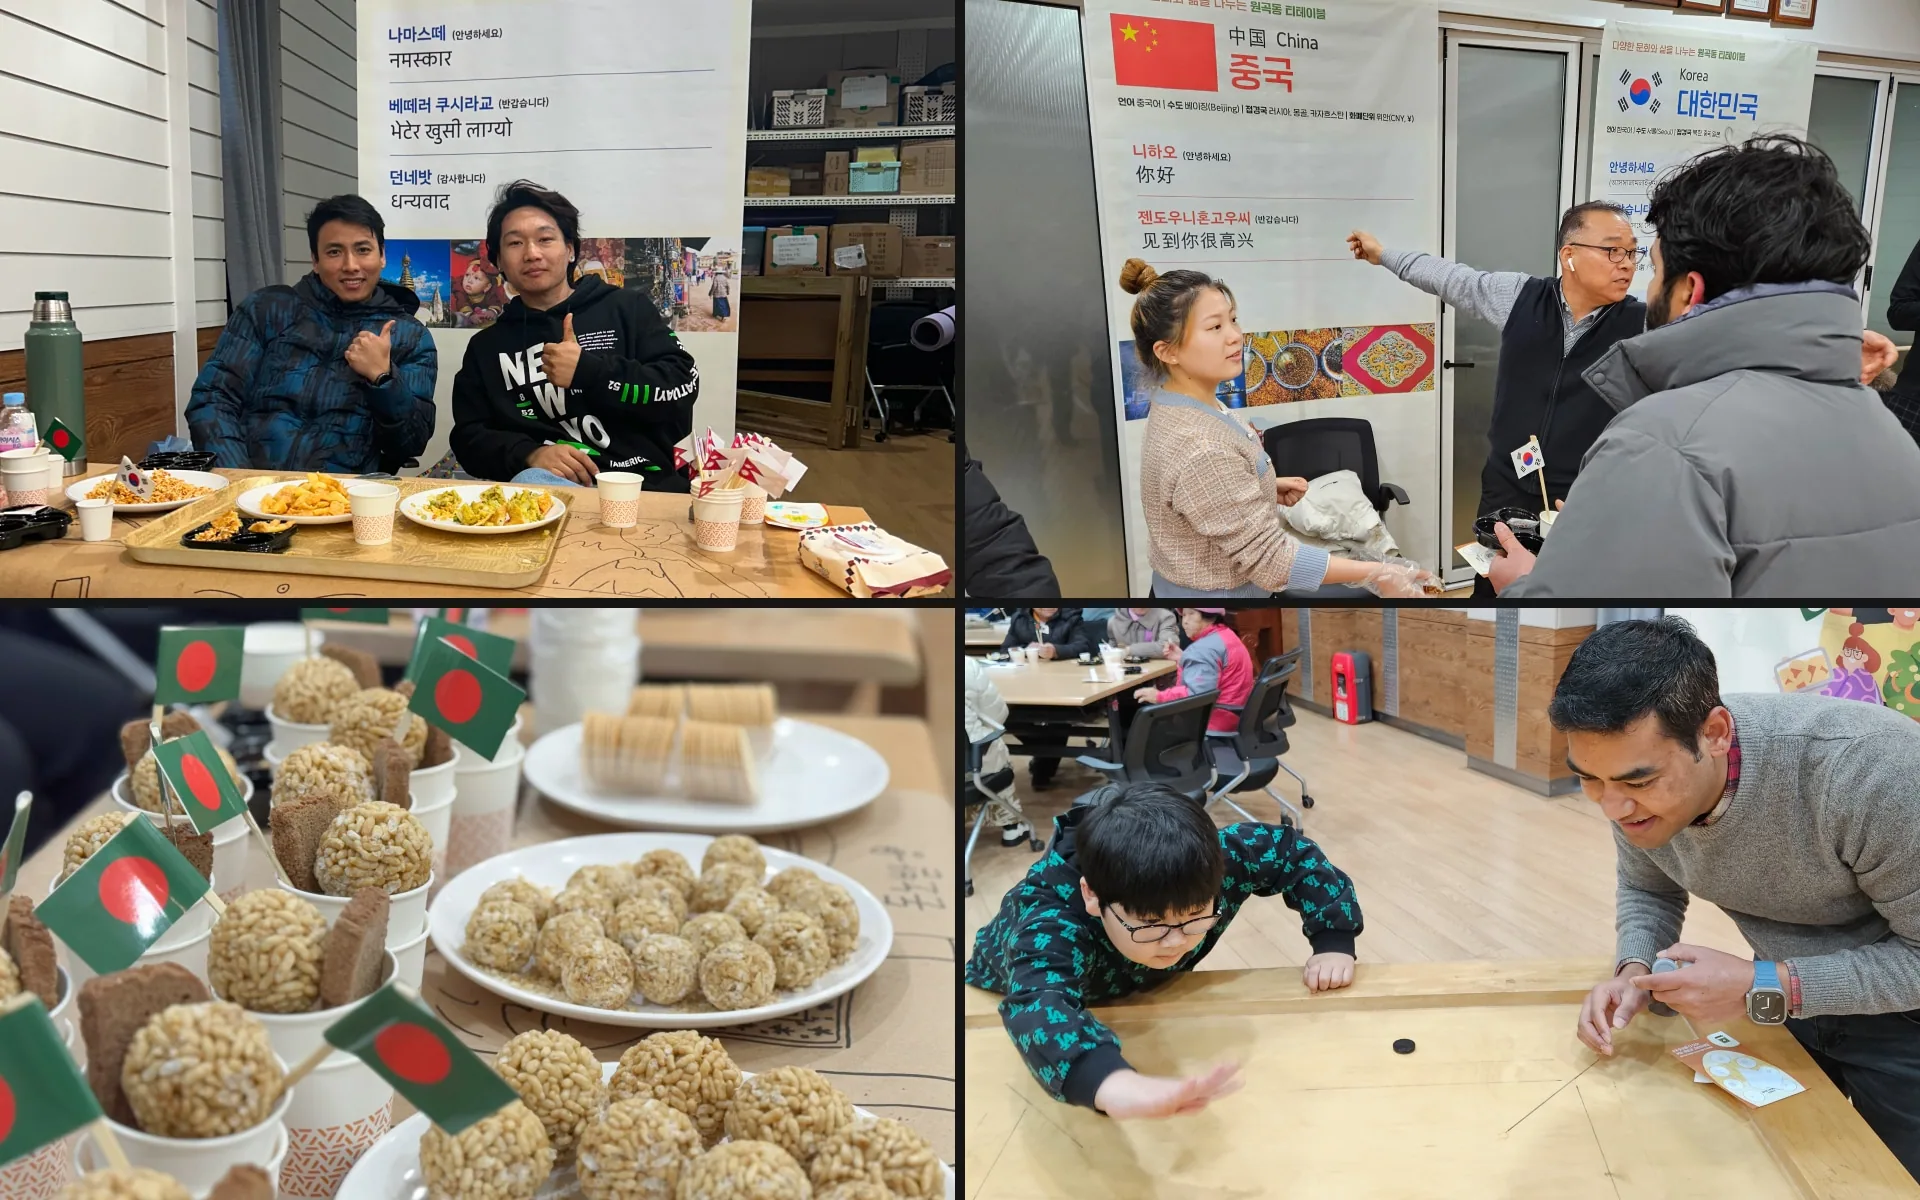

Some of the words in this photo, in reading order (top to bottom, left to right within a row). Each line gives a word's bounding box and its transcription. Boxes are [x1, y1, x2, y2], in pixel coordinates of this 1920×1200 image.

[1250, 1, 1282, 16] 원곡동
[1285, 4, 1327, 20] 티테이블
[388, 24, 446, 43] 나마스떼
[452, 28, 503, 41] (안녕하세요)
[1229, 26, 1266, 49] 中国
[1276, 31, 1319, 51] China
[1612, 40, 1635, 52] 다양한
[388, 51, 453, 68] नमस्कार
[1229, 53, 1293, 93] 중국
[1679, 68, 1709, 82] Korea
[389, 97, 431, 114] 베떼러
[435, 95, 494, 113] 쿠시라교
[498, 97, 549, 110] (반갑습니다)
[1118, 97, 1135, 107] 언어
[1136, 98, 1161, 109] 중국어
[1167, 100, 1183, 110] 수도
[1184, 101, 1240, 114] 베이징(Beijing)
[1677, 89, 1758, 121] 대한민국
[424, 118, 462, 145] खुसी
[465, 117, 513, 138] लाग्यो
[1133, 143, 1178, 160] 니하오
[1182, 150, 1232, 163] (안녕하세요)
[1135, 165, 1176, 184] 你好
[1609, 161, 1655, 174] 안녕하세요
[390, 169, 432, 186] 던네밧
[437, 173, 486, 184] (감사합니다)
[391, 194, 451, 210] धन्यवाद
[1137, 209, 1251, 226] 젠도우니혼고우씨
[1254, 215, 1299, 225] (반갑습니다)
[1141, 231, 1255, 250] 见到你很高兴
